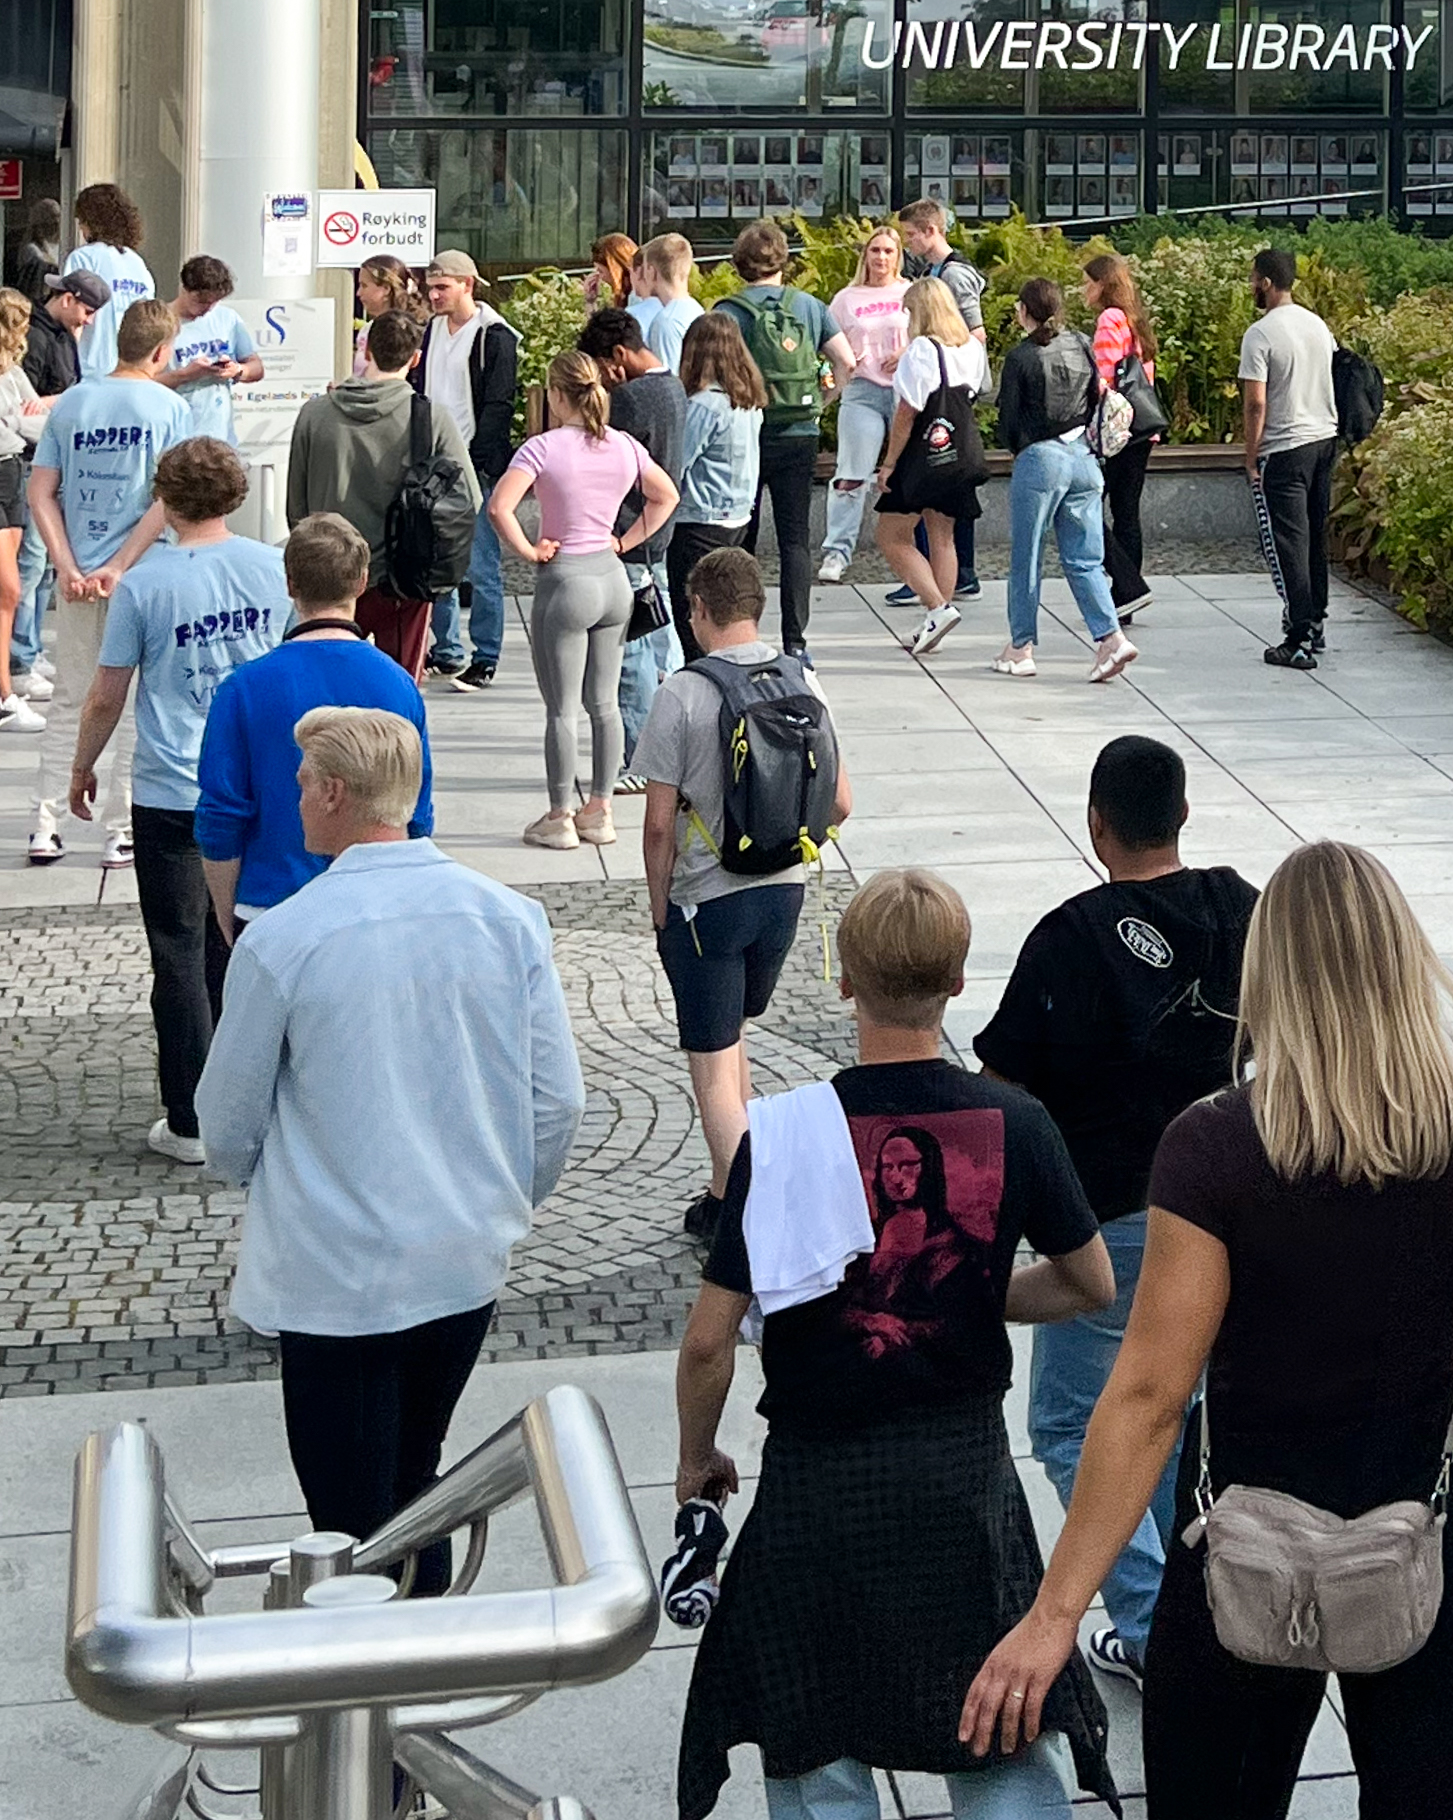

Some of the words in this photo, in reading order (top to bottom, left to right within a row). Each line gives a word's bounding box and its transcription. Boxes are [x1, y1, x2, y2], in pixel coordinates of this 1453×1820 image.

[860, 20, 1198, 71] UNIVERSITY
[1205, 22, 1434, 72] LIBRARY
[362, 212, 427, 228] Røyking
[361, 231, 424, 245] forbudt
